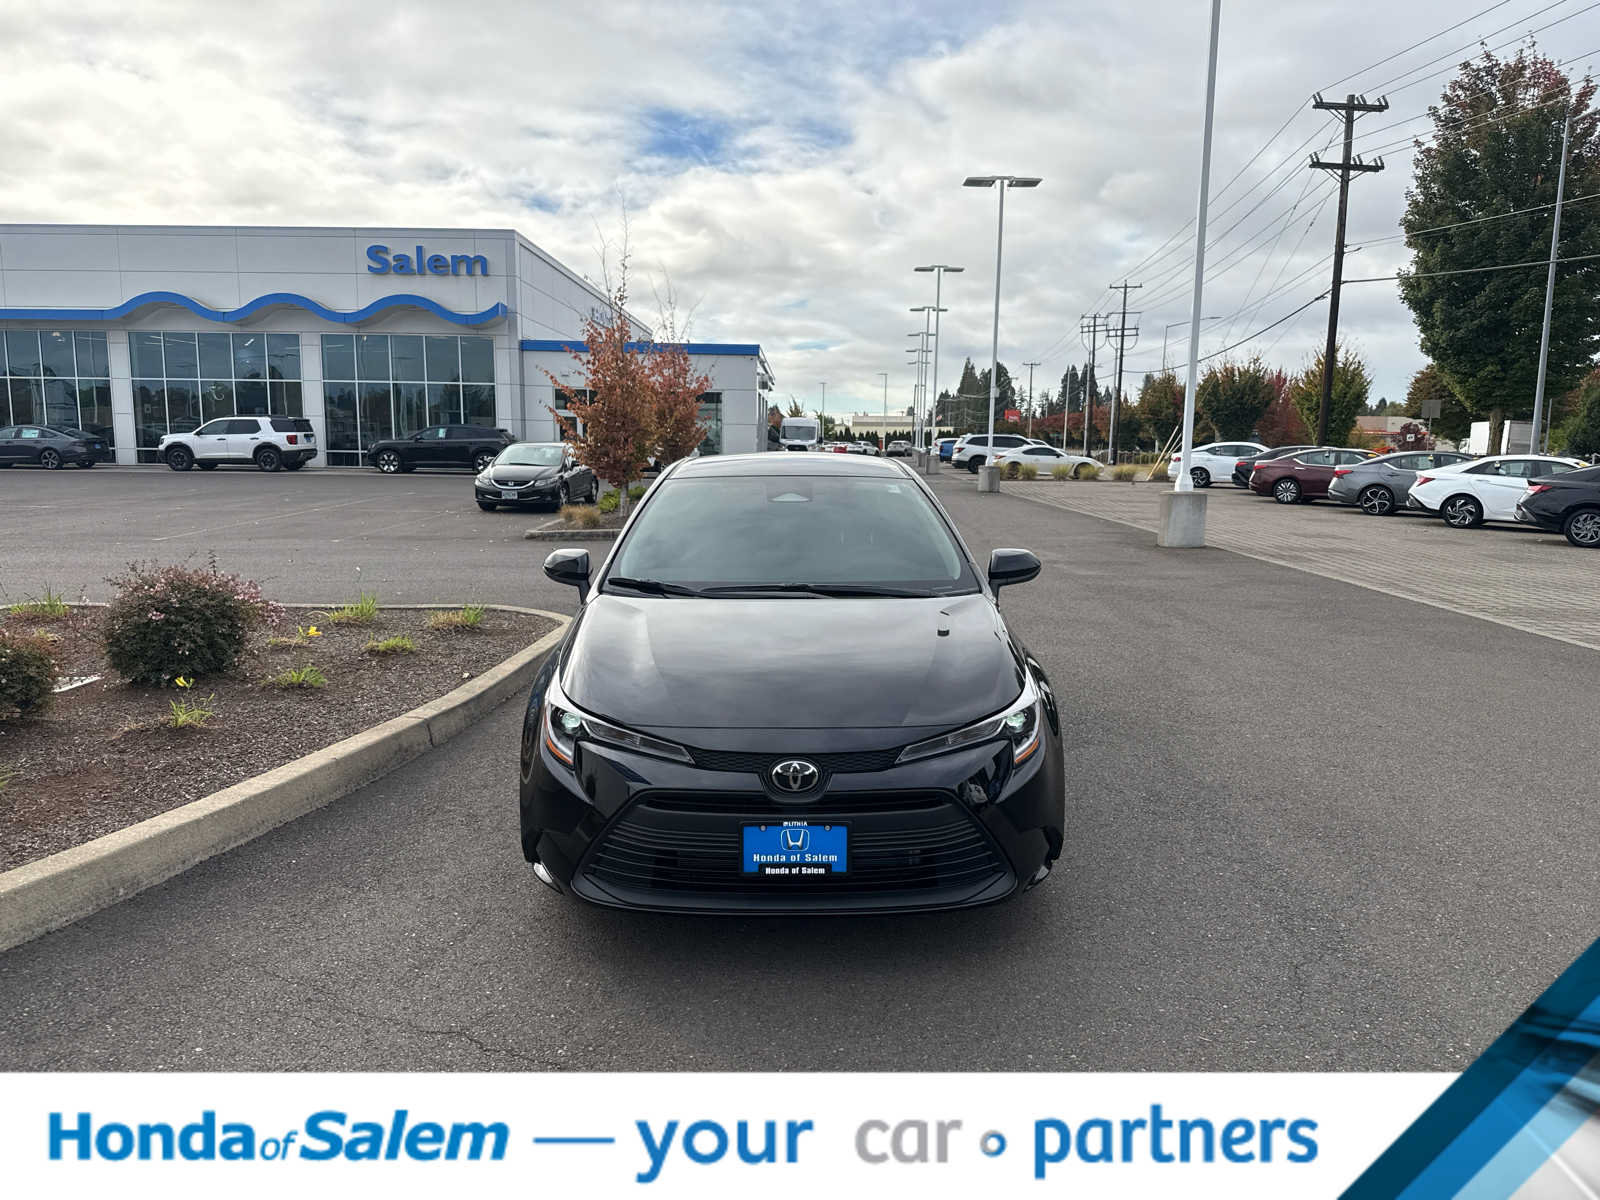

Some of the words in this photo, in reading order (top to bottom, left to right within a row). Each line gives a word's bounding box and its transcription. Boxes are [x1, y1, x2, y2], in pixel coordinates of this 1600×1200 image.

[365, 244, 489, 276] Salem
[753, 853, 786, 862] Honda
[790, 853, 801, 862] of
[804, 853, 838, 862] Salem
[765, 867, 789, 875] Honda
[791, 867, 799, 875] of
[801, 866, 825, 875] Salem
